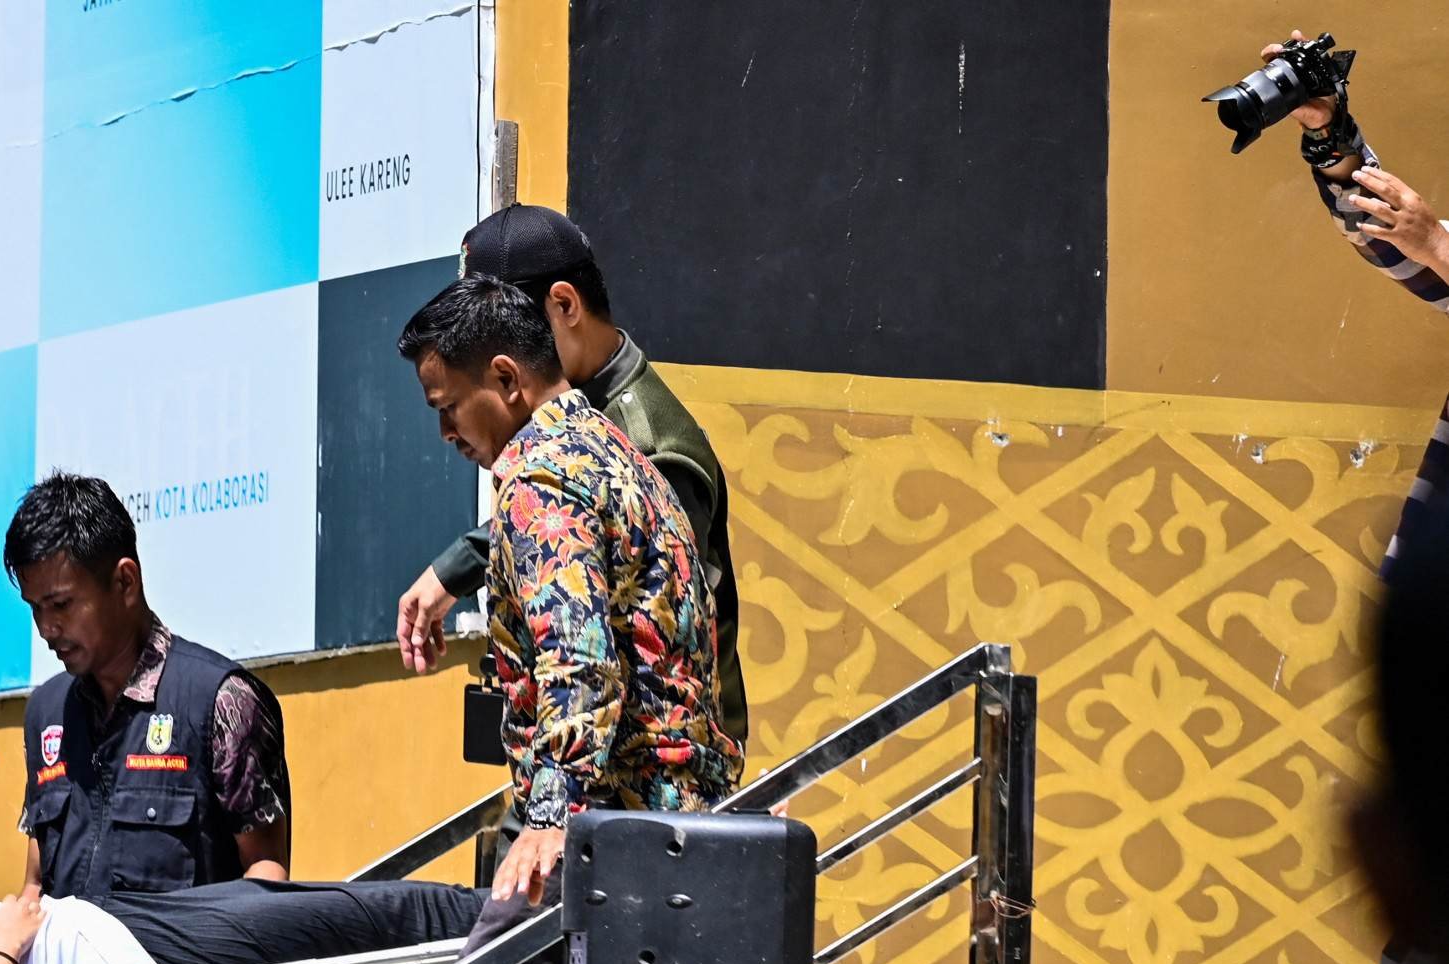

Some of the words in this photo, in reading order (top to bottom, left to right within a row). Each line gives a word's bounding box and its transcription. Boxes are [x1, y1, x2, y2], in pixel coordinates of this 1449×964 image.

[326, 167, 354, 202] ULEE
[359, 153, 411, 195] KARENG
[121, 490, 150, 523] CEH
[155, 486, 186, 520] KOTA
[192, 471, 269, 513] KOLABORASI
